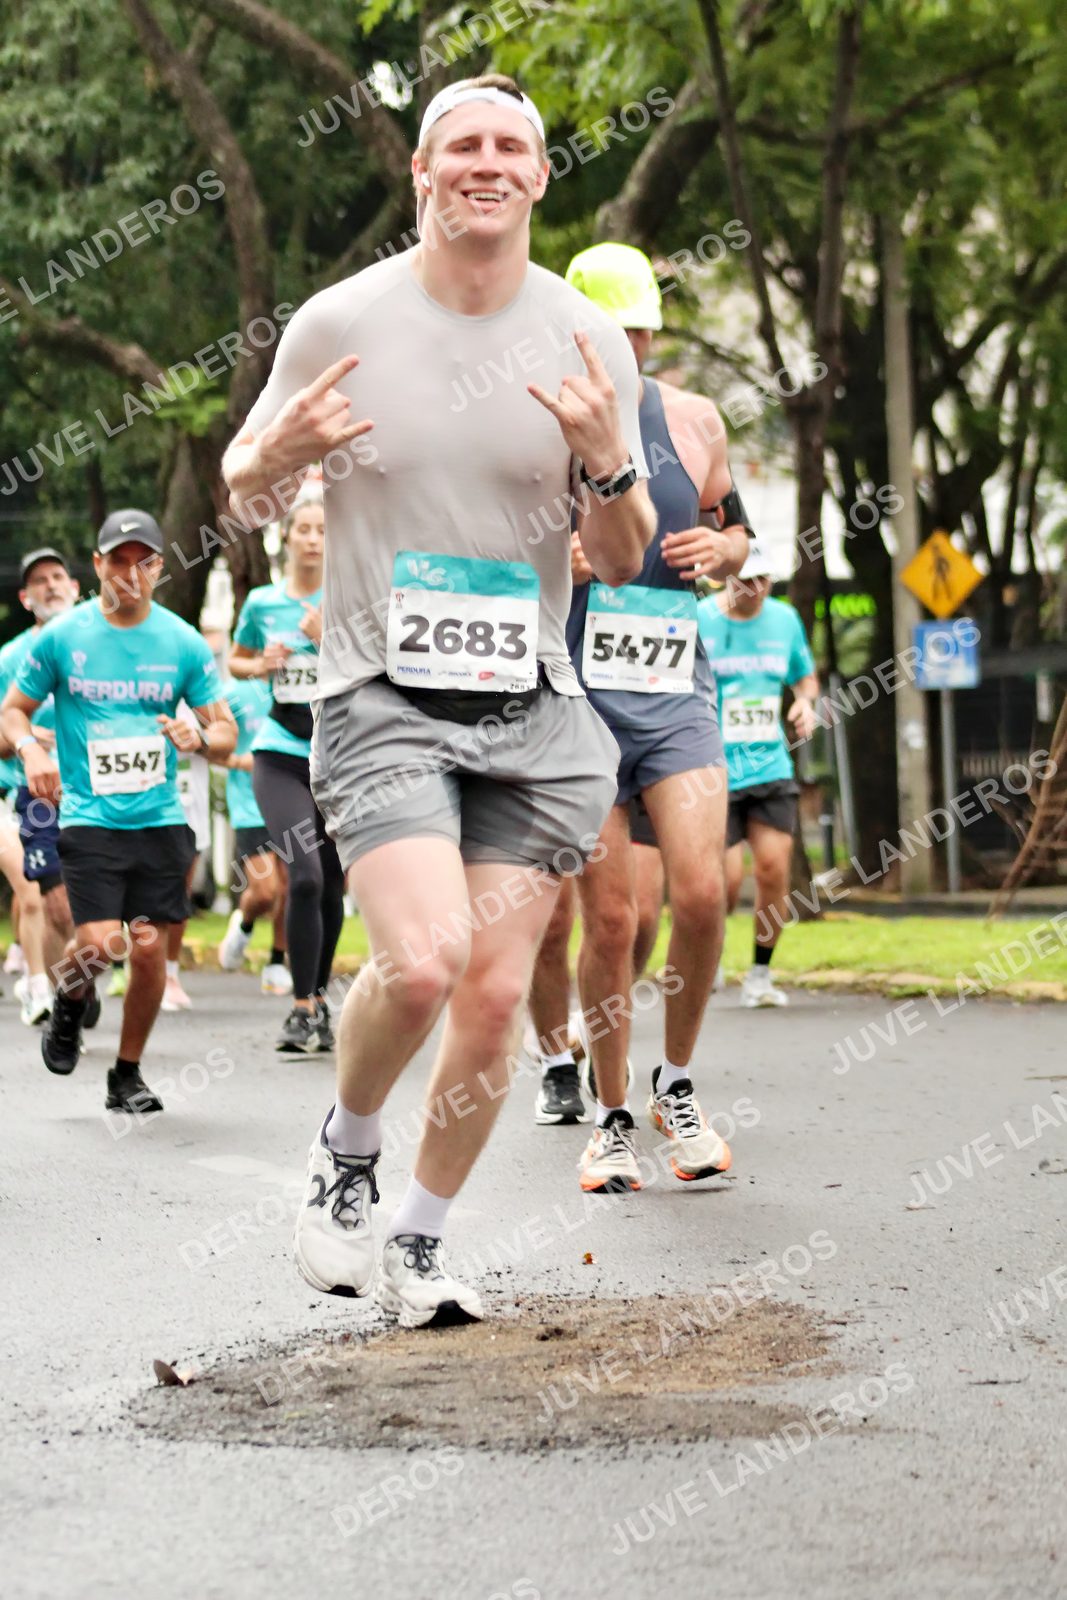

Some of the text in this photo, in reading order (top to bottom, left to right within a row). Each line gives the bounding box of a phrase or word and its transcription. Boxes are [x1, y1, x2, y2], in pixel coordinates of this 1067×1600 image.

[399, 614, 527, 660] 2683
[592, 633, 687, 668] 5477
[68, 675, 174, 702] PERDURA
[728, 709, 774, 726] 5379
[95, 750, 161, 775] 3547
